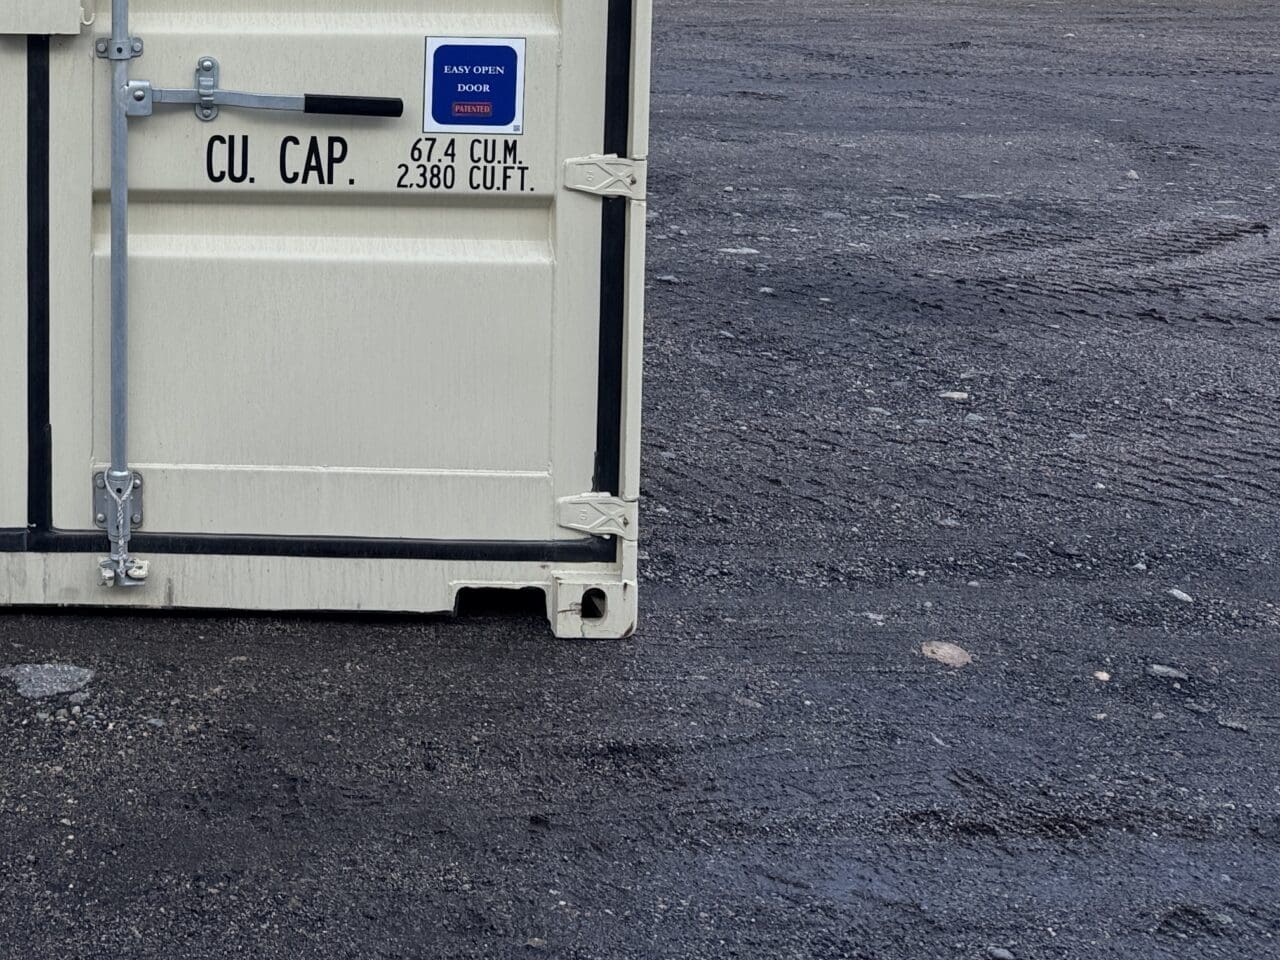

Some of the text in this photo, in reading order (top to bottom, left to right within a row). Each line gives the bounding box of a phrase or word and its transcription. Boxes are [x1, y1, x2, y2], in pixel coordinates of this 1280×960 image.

[443, 65, 505, 75] EASY OPEN
[457, 83, 490, 92] DOOR
[455, 105, 490, 113] PATENTED
[206, 135, 523, 185] CU. CAP. 67.4 CU.M.
[396, 163, 534, 191] 2,380 CU.FT.
